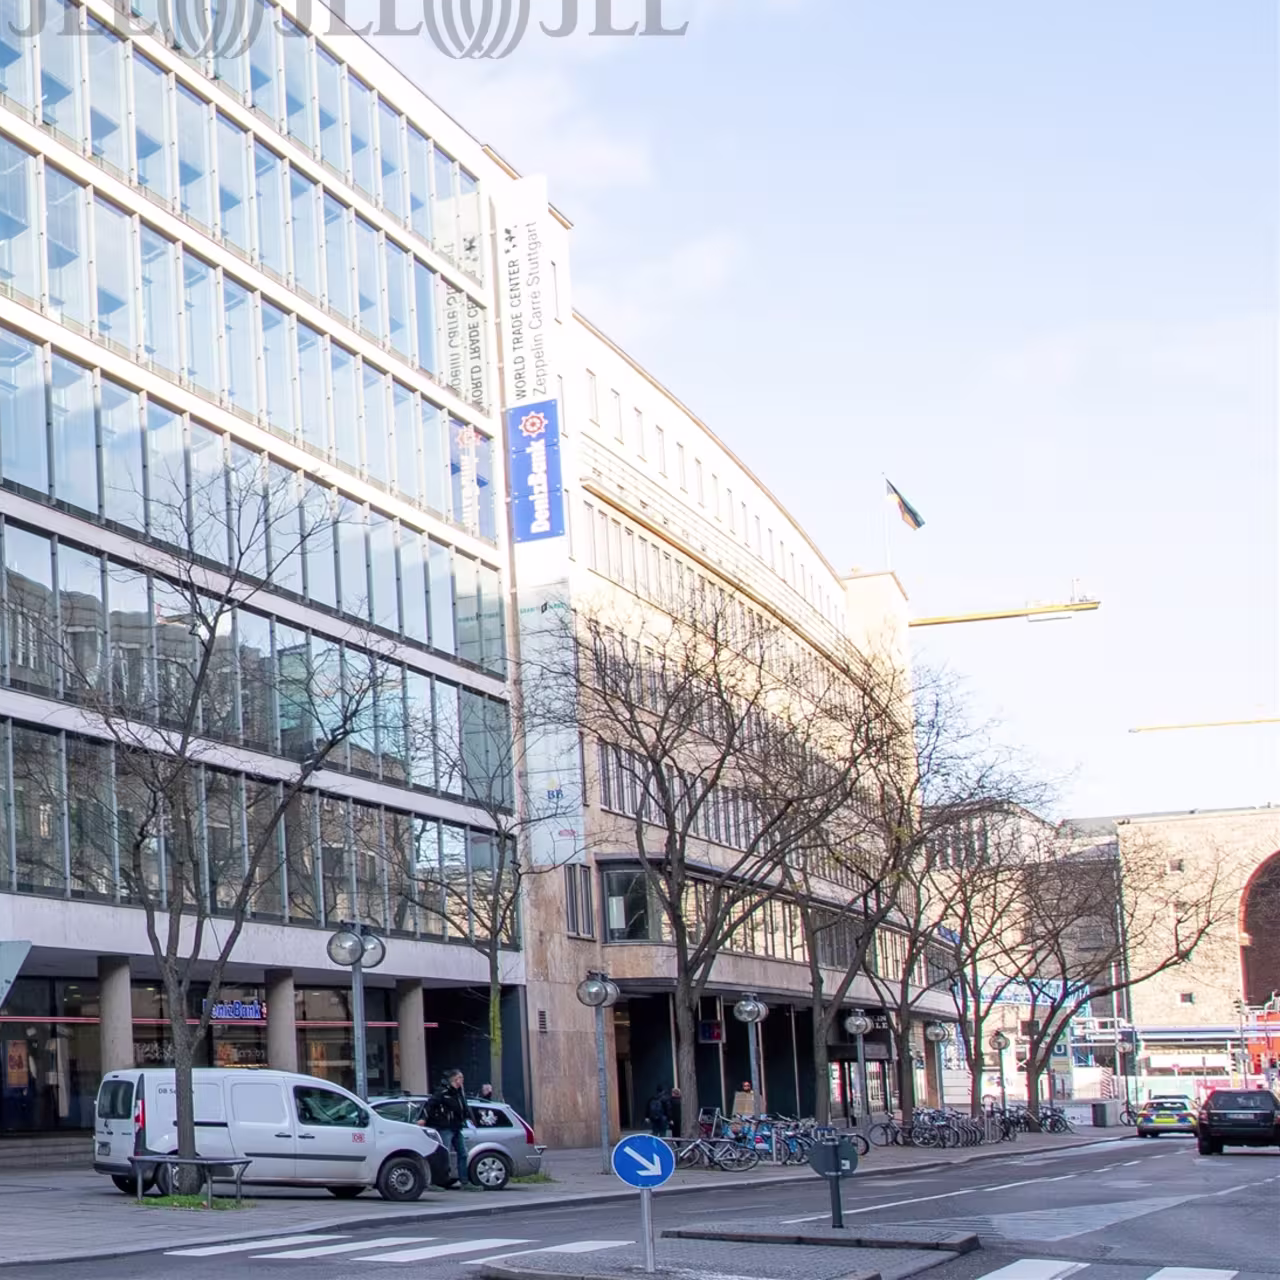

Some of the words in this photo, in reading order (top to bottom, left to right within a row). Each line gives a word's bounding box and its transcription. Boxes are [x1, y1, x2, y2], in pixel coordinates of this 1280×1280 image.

[525, 221, 542, 288] Stuttgart
[508, 259, 521, 308] CENTER
[512, 312, 524, 353] TRADE
[513, 355, 527, 400] WORLD
[532, 333, 547, 397] Zeppelin
[202, 999, 261, 1019] enizBank
